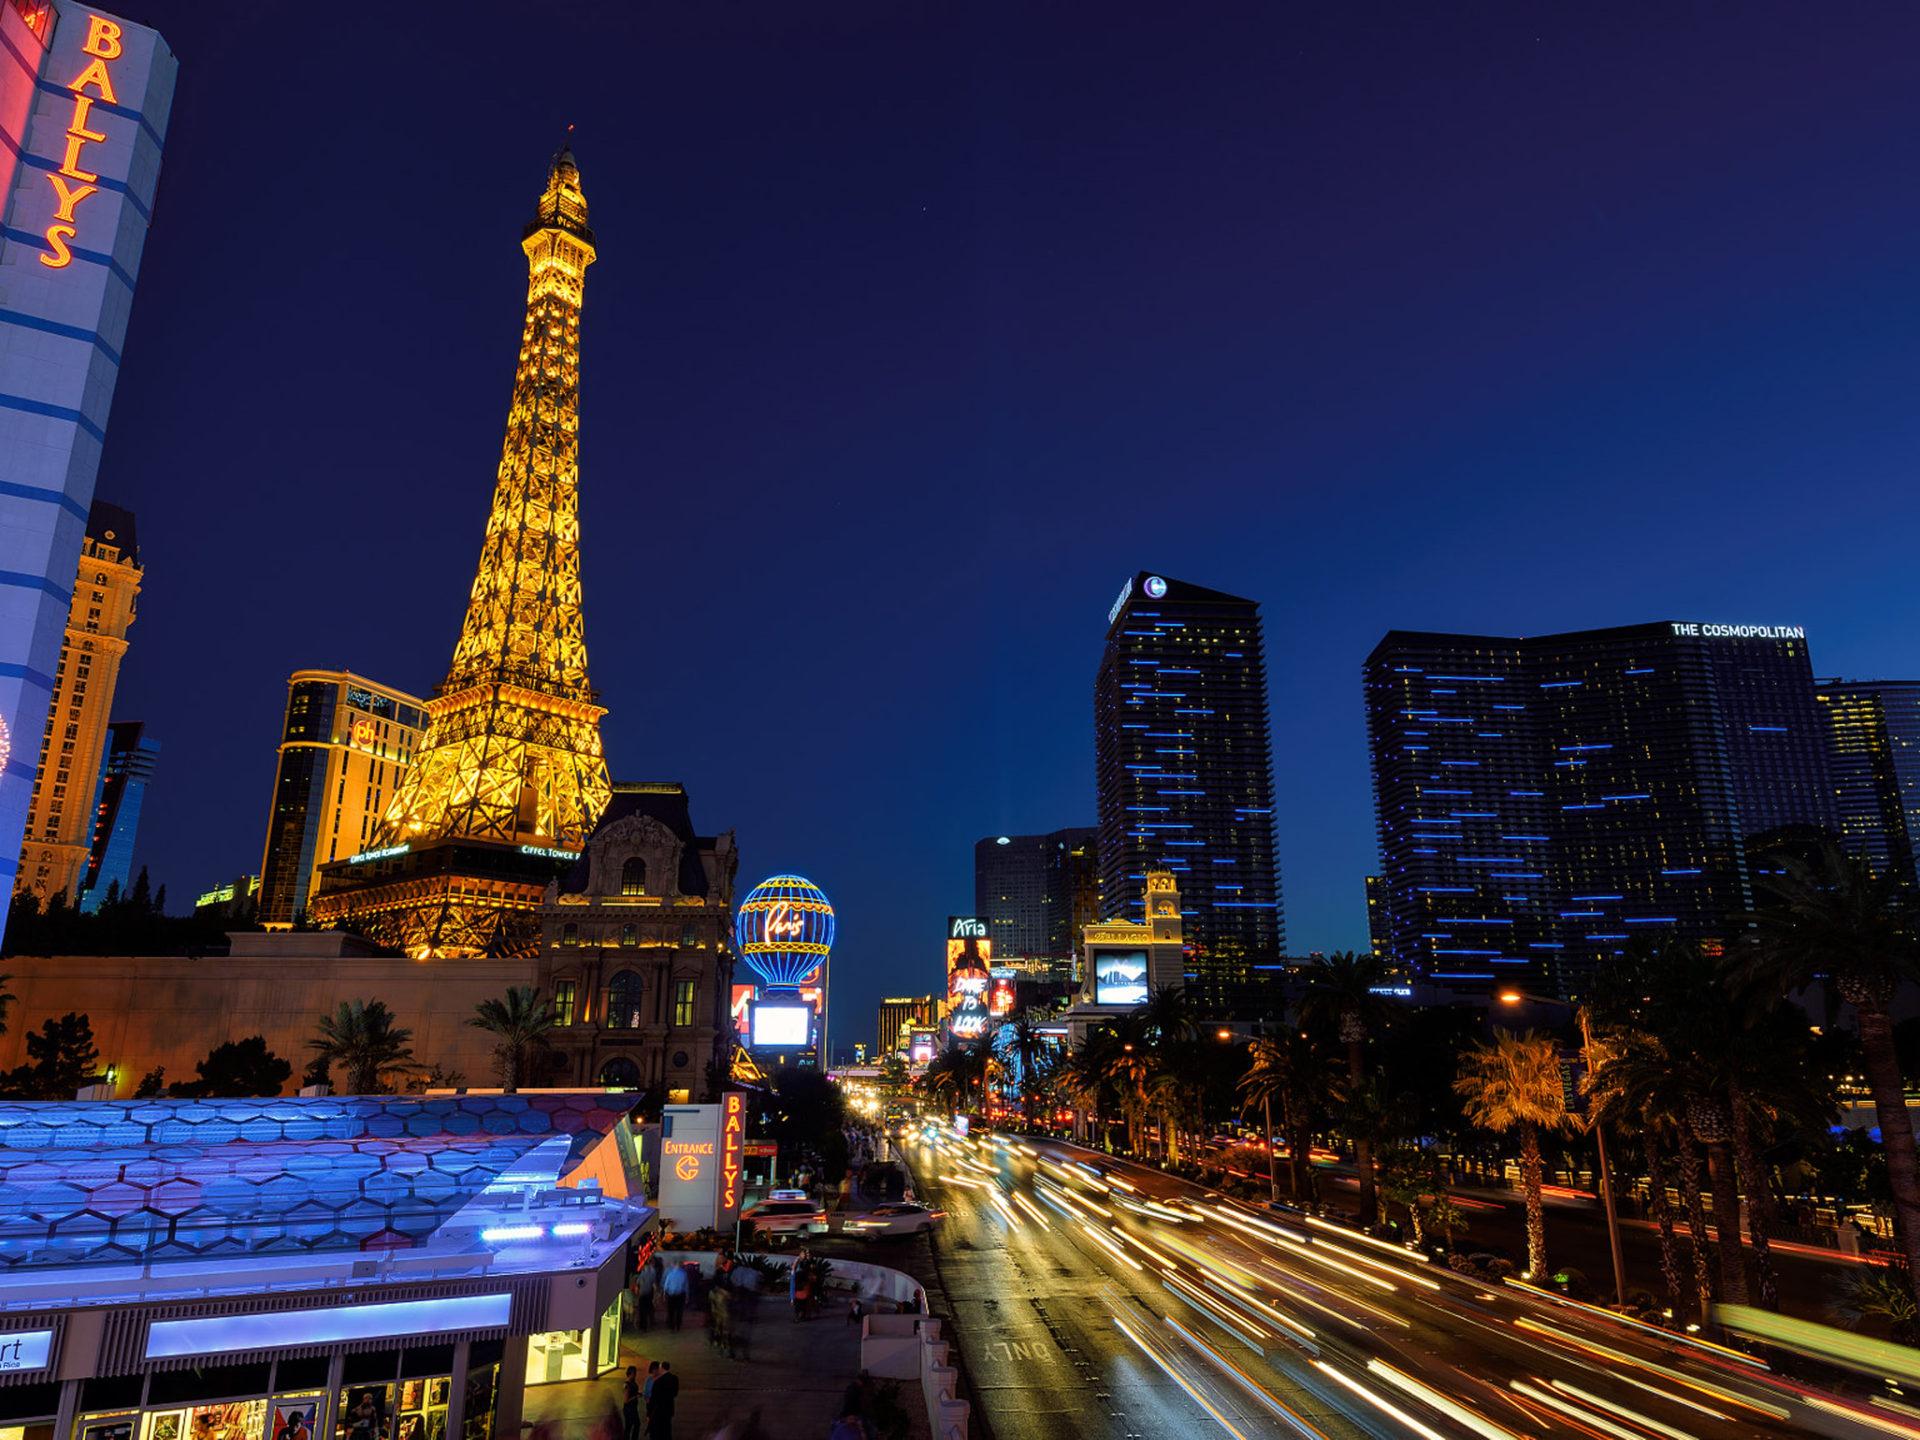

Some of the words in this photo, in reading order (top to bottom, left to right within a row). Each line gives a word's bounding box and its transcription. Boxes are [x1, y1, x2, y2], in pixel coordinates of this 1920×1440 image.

[40, 14, 122, 268] BALLYS
[1671, 623, 1699, 636] THE
[1702, 624, 1804, 638] COSMOPOLITAN
[764, 901, 804, 946] Paris
[953, 919, 985, 937] Aria
[953, 1016, 987, 1033] LOOK
[724, 1095, 740, 1209] BALLYS
